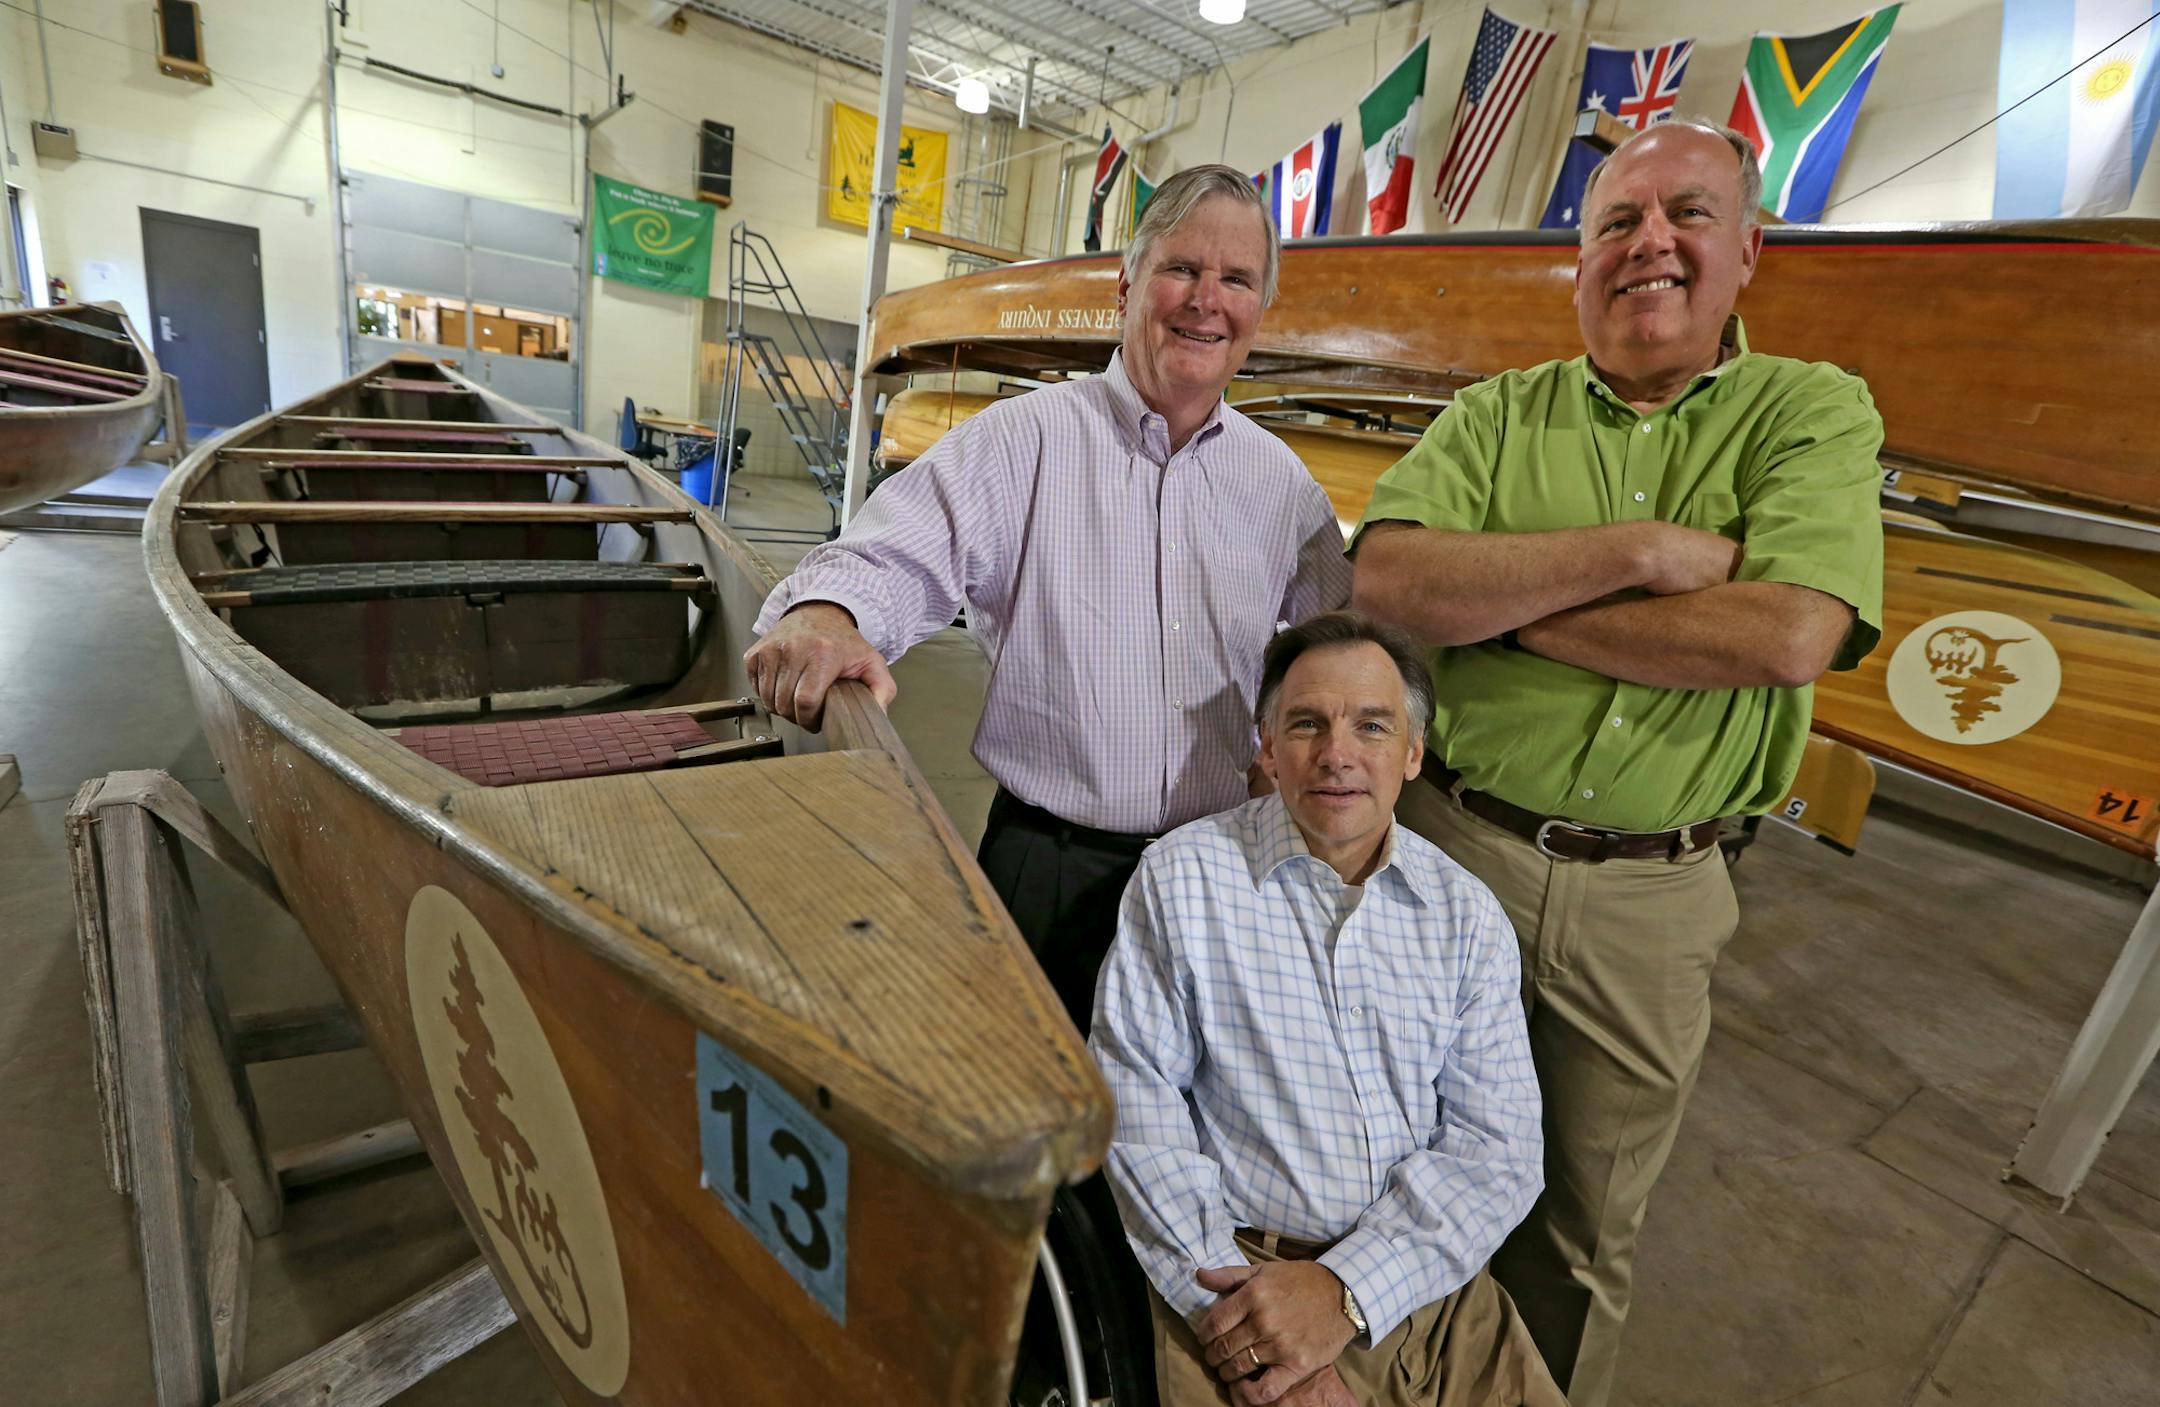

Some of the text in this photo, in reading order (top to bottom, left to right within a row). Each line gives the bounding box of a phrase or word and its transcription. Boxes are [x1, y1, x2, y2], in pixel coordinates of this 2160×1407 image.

[998, 304, 1052, 329] INQUIRY
[1787, 801, 1804, 816] 5
[2097, 792, 2140, 823] 14
[711, 1082, 830, 1272] 13
